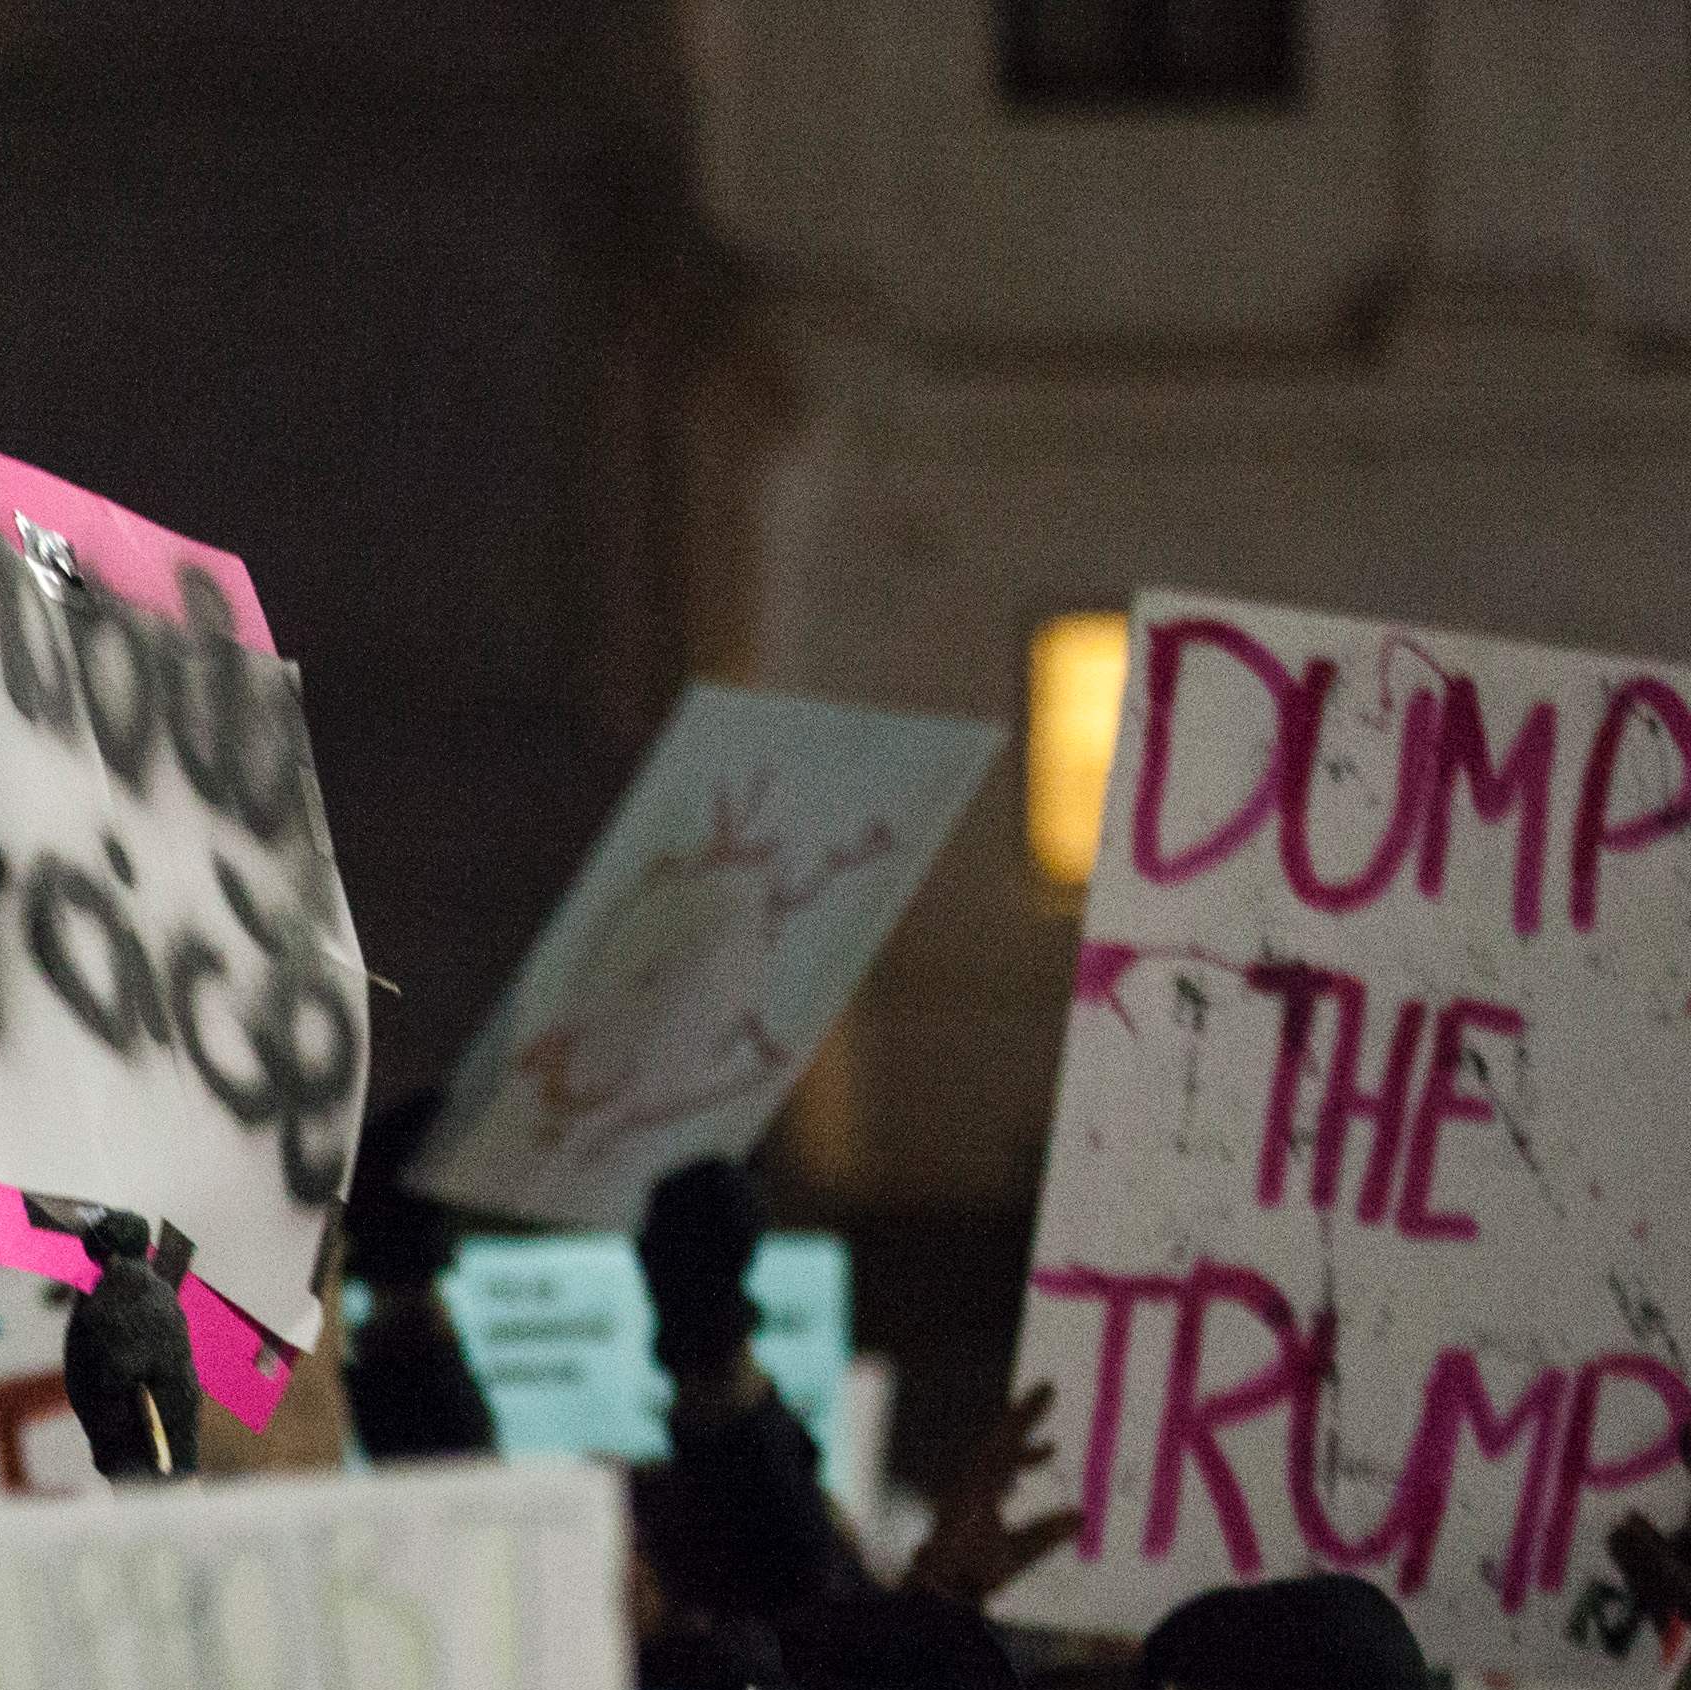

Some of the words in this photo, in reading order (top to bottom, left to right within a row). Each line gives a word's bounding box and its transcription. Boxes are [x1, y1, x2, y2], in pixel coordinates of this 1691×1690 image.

[1132, 619, 1691, 935] DUMP
[1247, 960, 1524, 1241] THE
[1031, 1258, 1691, 1614] TRUMP
